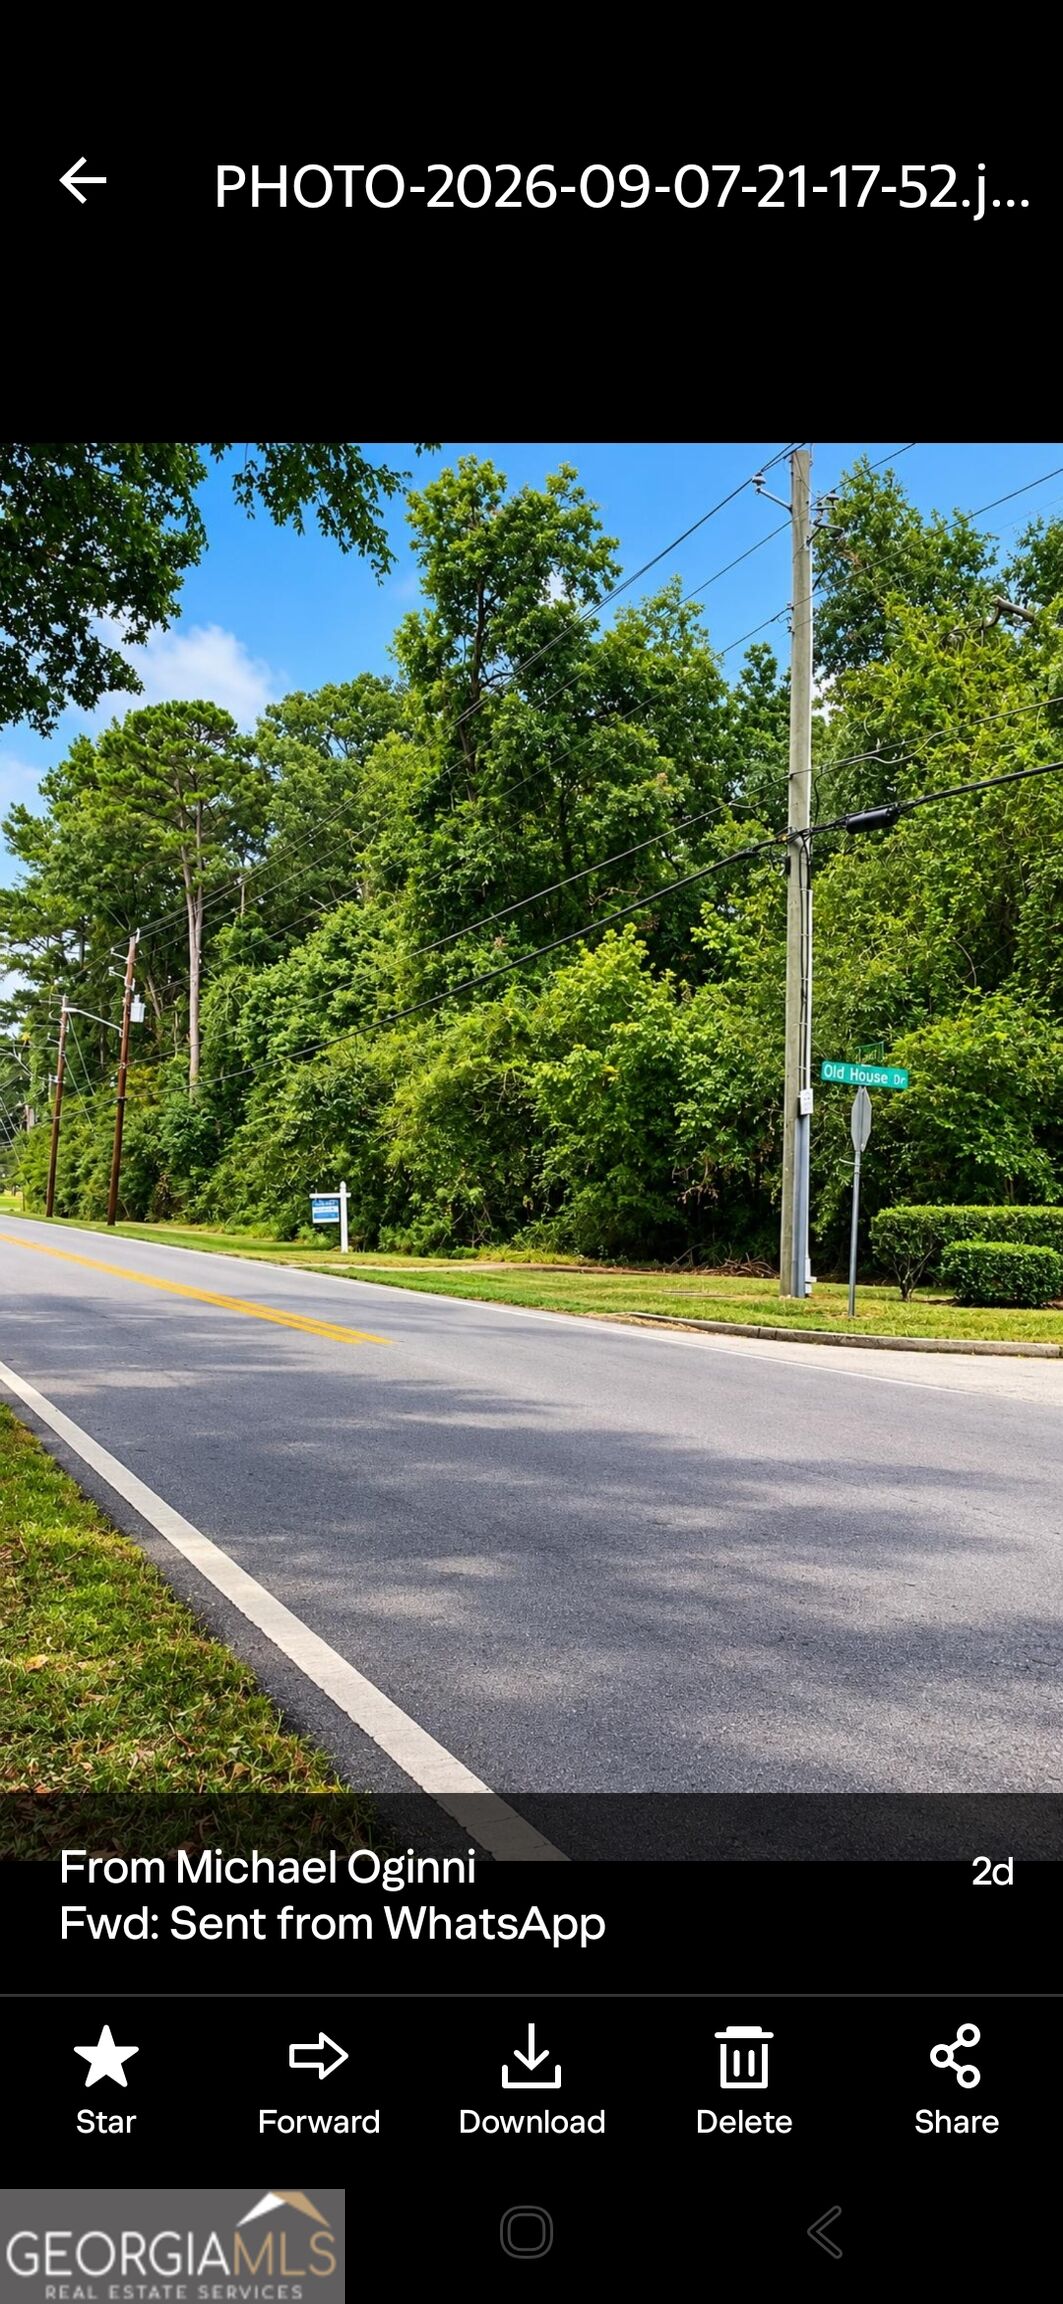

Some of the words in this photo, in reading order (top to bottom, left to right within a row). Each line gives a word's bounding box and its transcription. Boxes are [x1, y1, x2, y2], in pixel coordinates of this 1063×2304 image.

[824, 1064, 844, 1079] Old
[850, 1068, 888, 1083] House
[894, 1074, 905, 1085] Dr
